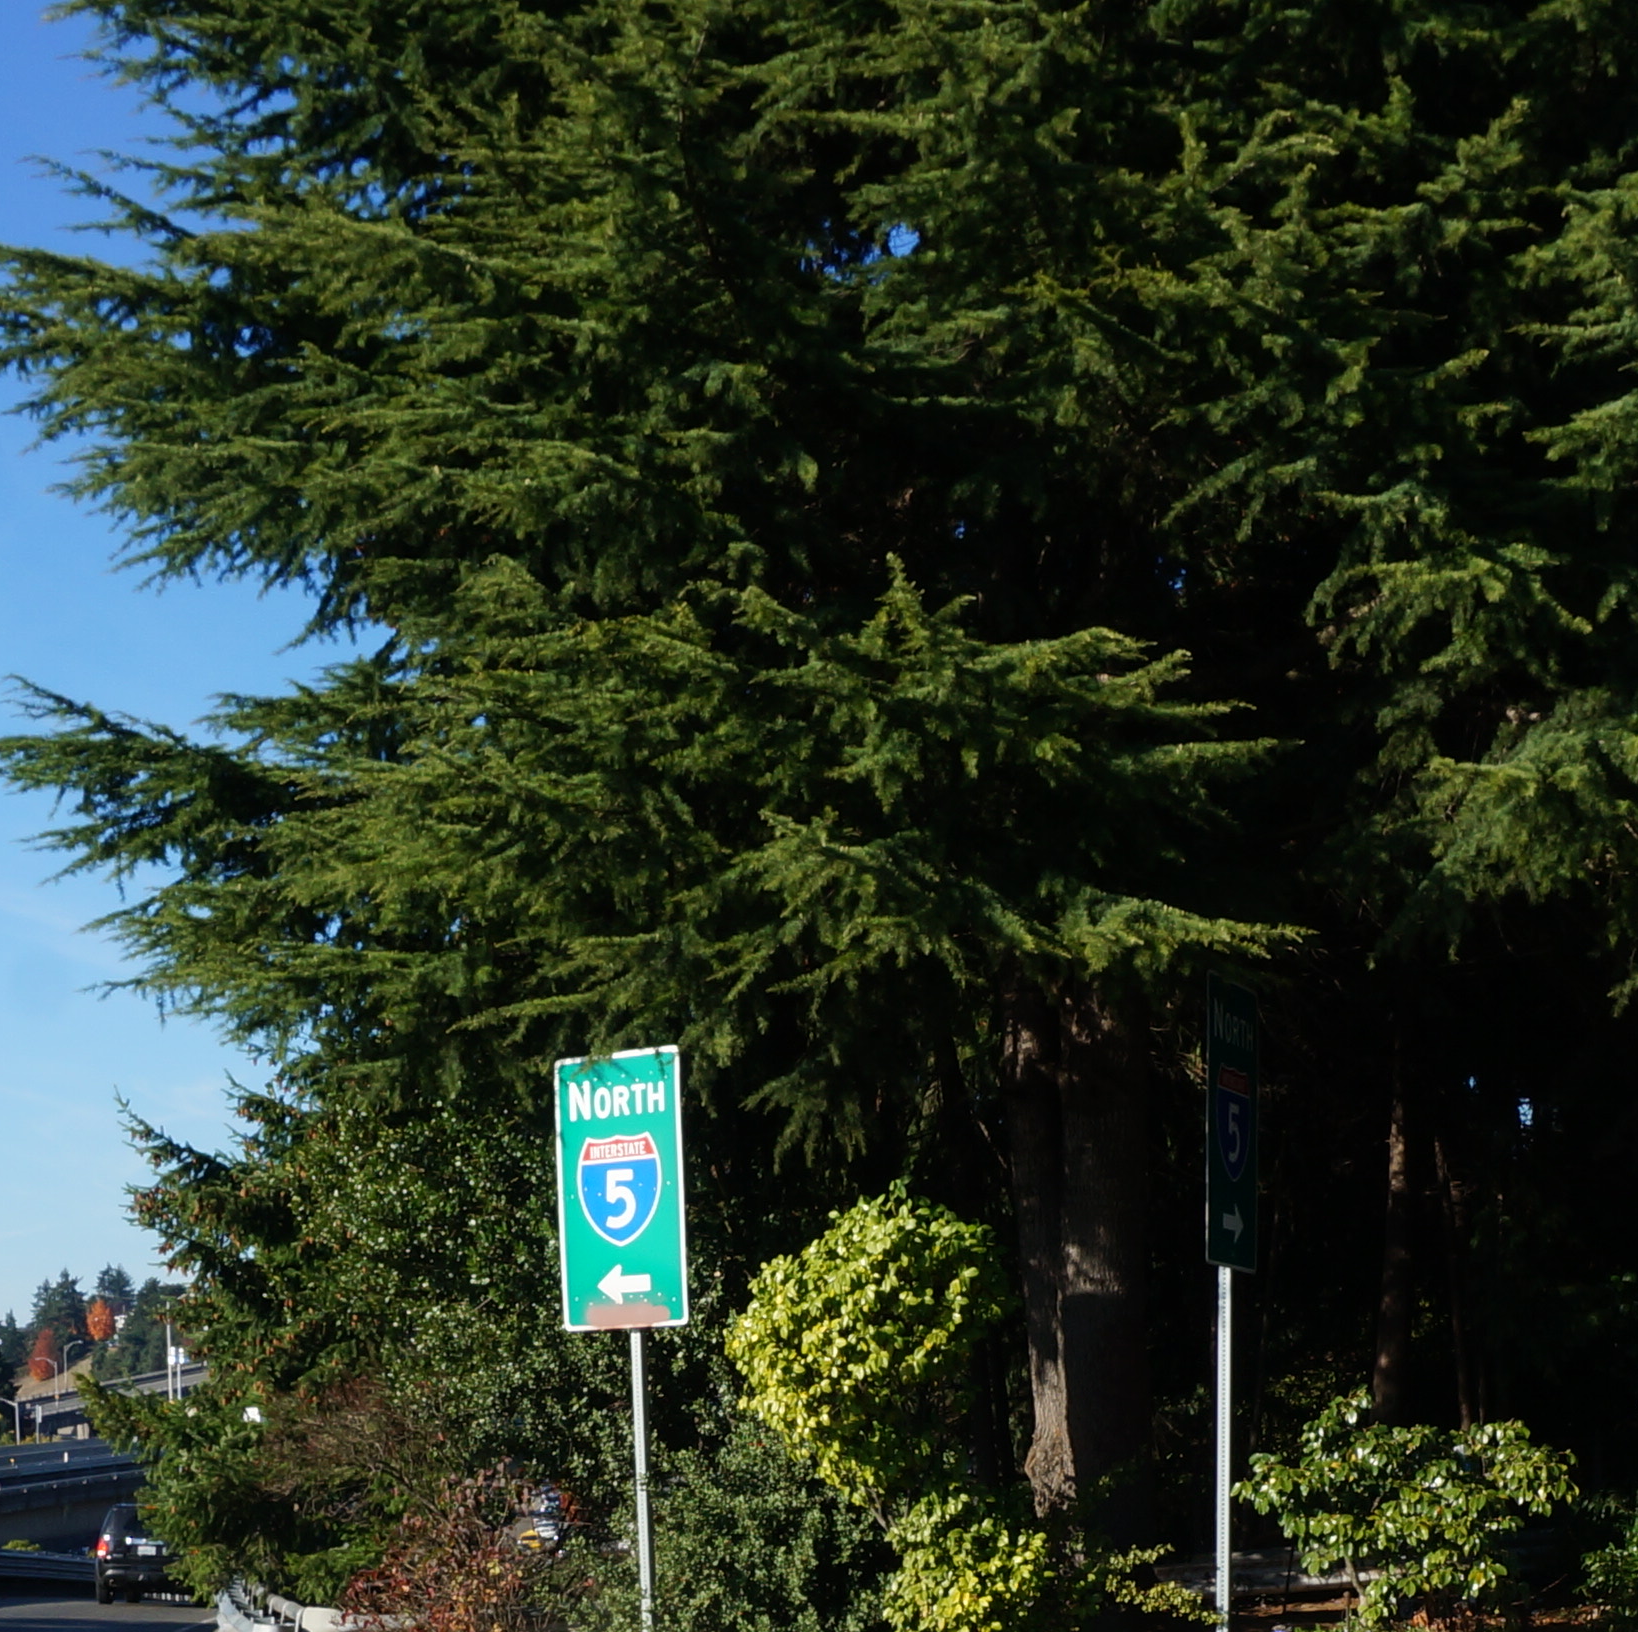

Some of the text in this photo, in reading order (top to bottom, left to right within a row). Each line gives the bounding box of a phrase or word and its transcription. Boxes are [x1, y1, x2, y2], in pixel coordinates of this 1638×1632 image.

[1214, 997, 1255, 1052] NORTH
[568, 1080, 666, 1122] NORTH
[589, 1140, 647, 1160] INTERSTATE
[1227, 1103, 1241, 1163] 5
[605, 1168, 637, 1230] 5
